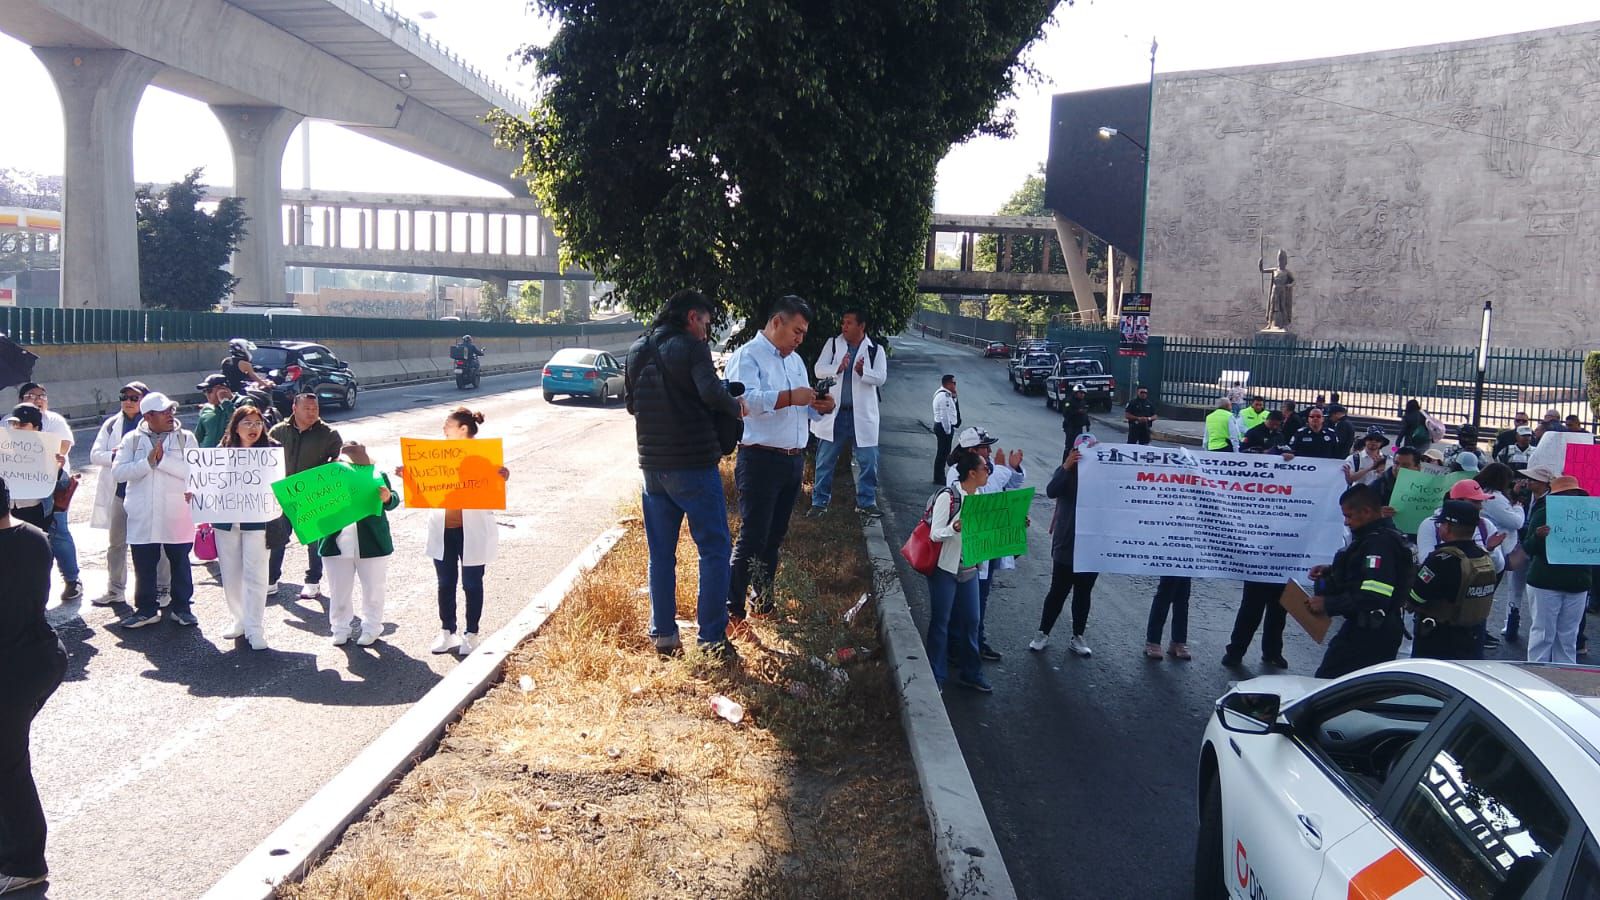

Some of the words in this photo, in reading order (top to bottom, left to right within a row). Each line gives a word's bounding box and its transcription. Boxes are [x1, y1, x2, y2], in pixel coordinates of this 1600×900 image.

[186, 448, 278, 467] QUEREMOS
[1200, 458, 1248, 468] ESTADO
[1274, 463, 1317, 472] MEXICO
[189, 469, 261, 490] NUESTROS
[1137, 471, 1293, 495] MANIFESTACION
[1195, 503, 1220, 511] LIBRE
[1106, 552, 1150, 560] CENTROS
[1246, 570, 1285, 578] LABORAL
